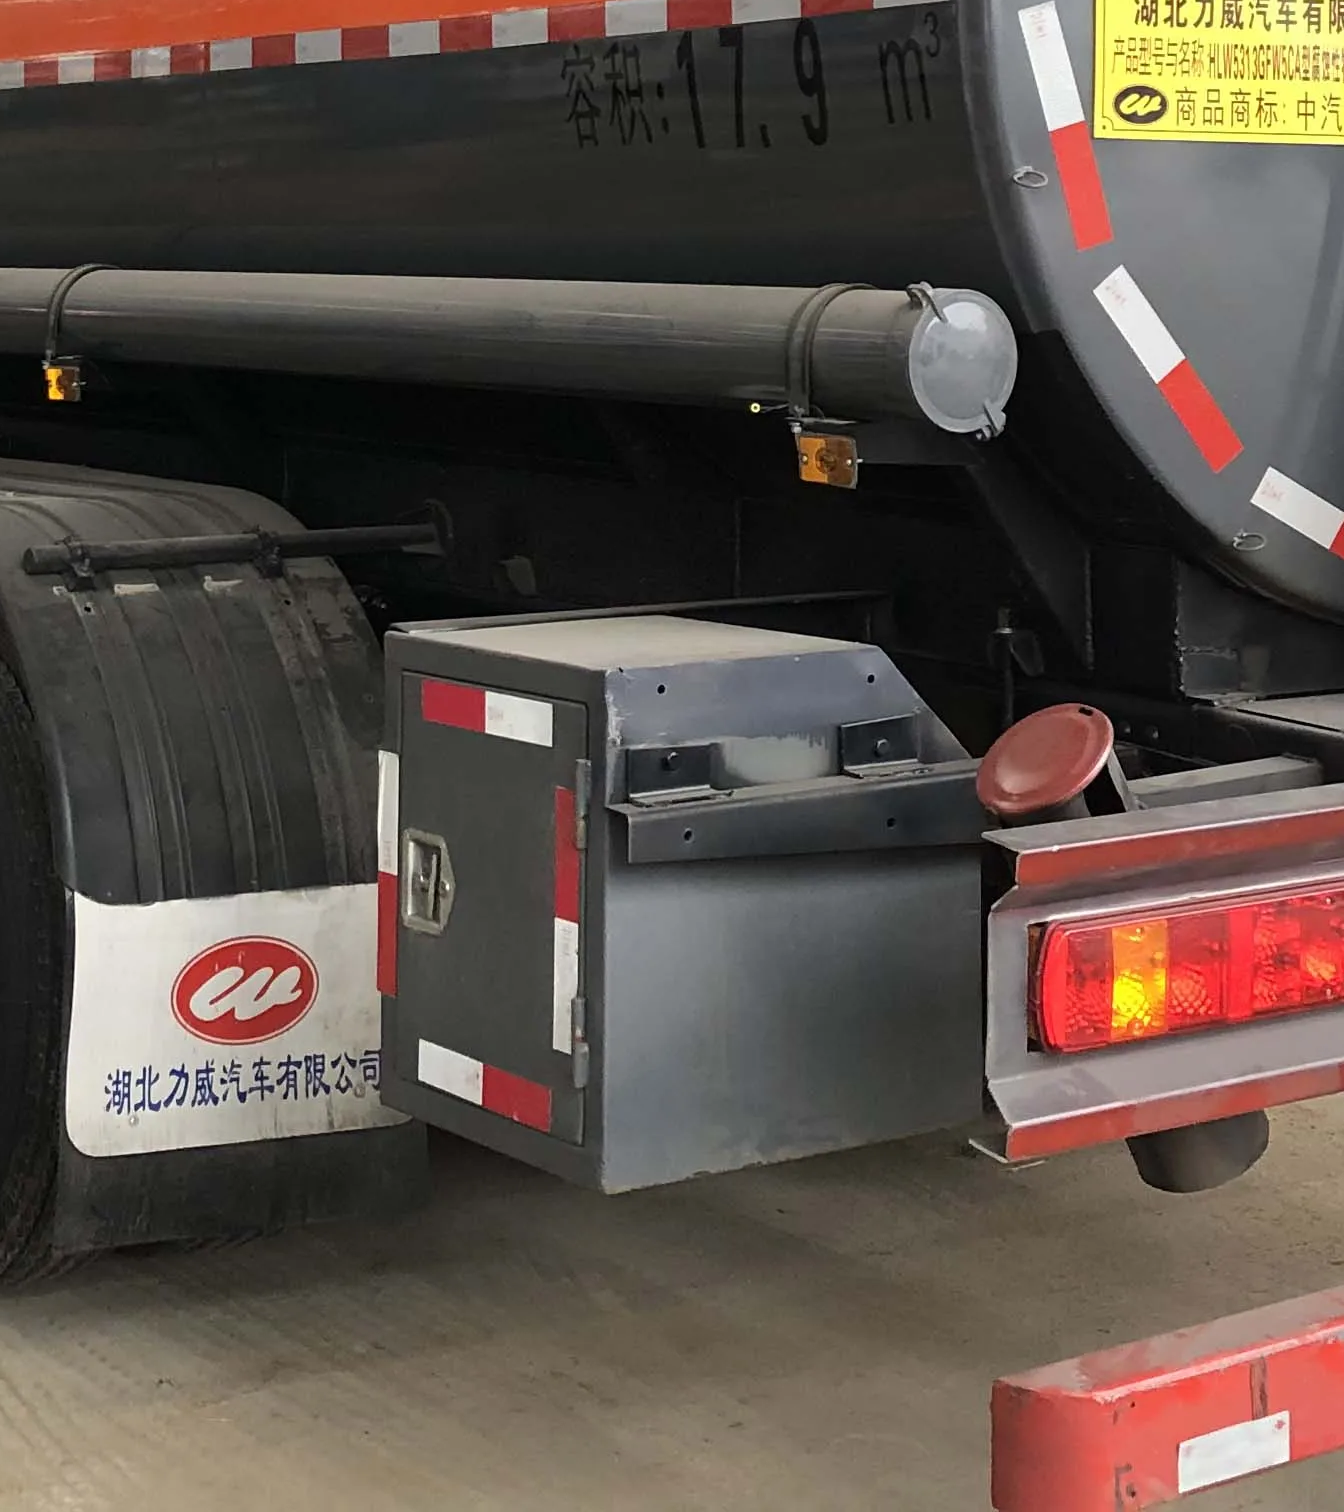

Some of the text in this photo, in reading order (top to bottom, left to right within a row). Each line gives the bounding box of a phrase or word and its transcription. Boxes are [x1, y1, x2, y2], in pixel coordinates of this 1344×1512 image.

[104, 1049, 382, 1114] 湖北力威汽车有限公司
